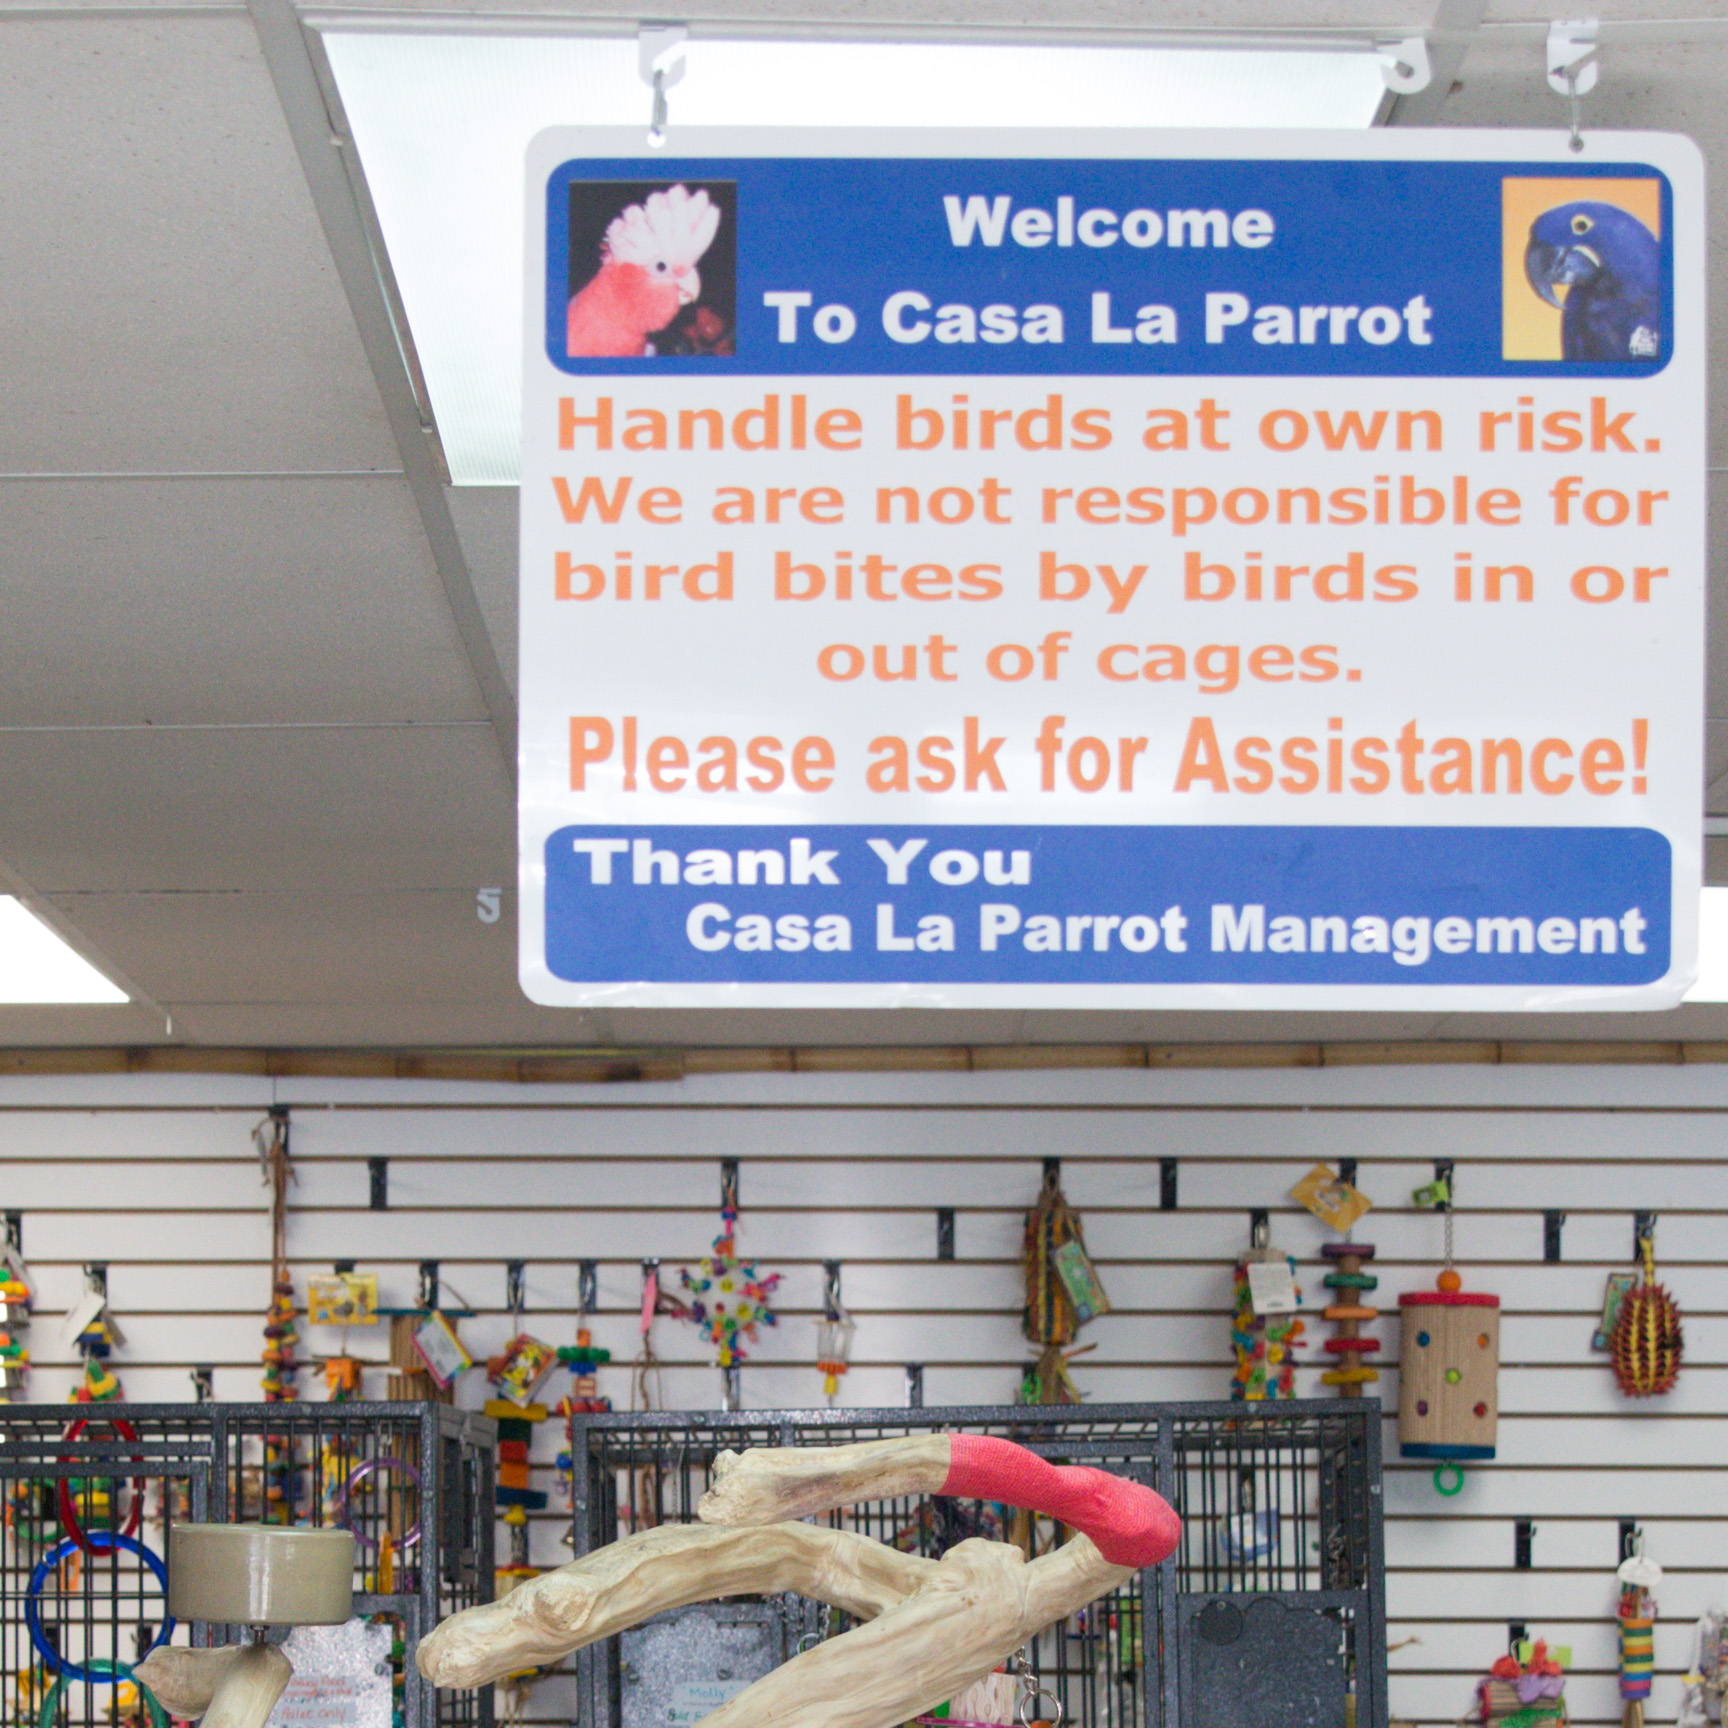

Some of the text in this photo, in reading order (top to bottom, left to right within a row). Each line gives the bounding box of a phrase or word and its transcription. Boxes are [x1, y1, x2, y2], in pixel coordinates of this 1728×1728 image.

[944, 195, 1275, 248] Welcome
[763, 291, 1432, 345] To Casa La Parrot
[559, 394, 1660, 452] Handle birds at own risk.
[552, 476, 1668, 536] We are not responsible for
[555, 551, 1668, 613] bird bites by birds in or
[818, 631, 1361, 693] out of cages.
[570, 716, 1648, 794] Please ask for Assistance!
[573, 838, 1031, 886] Thank You
[686, 902, 1647, 966] Casa La Parrot Management
